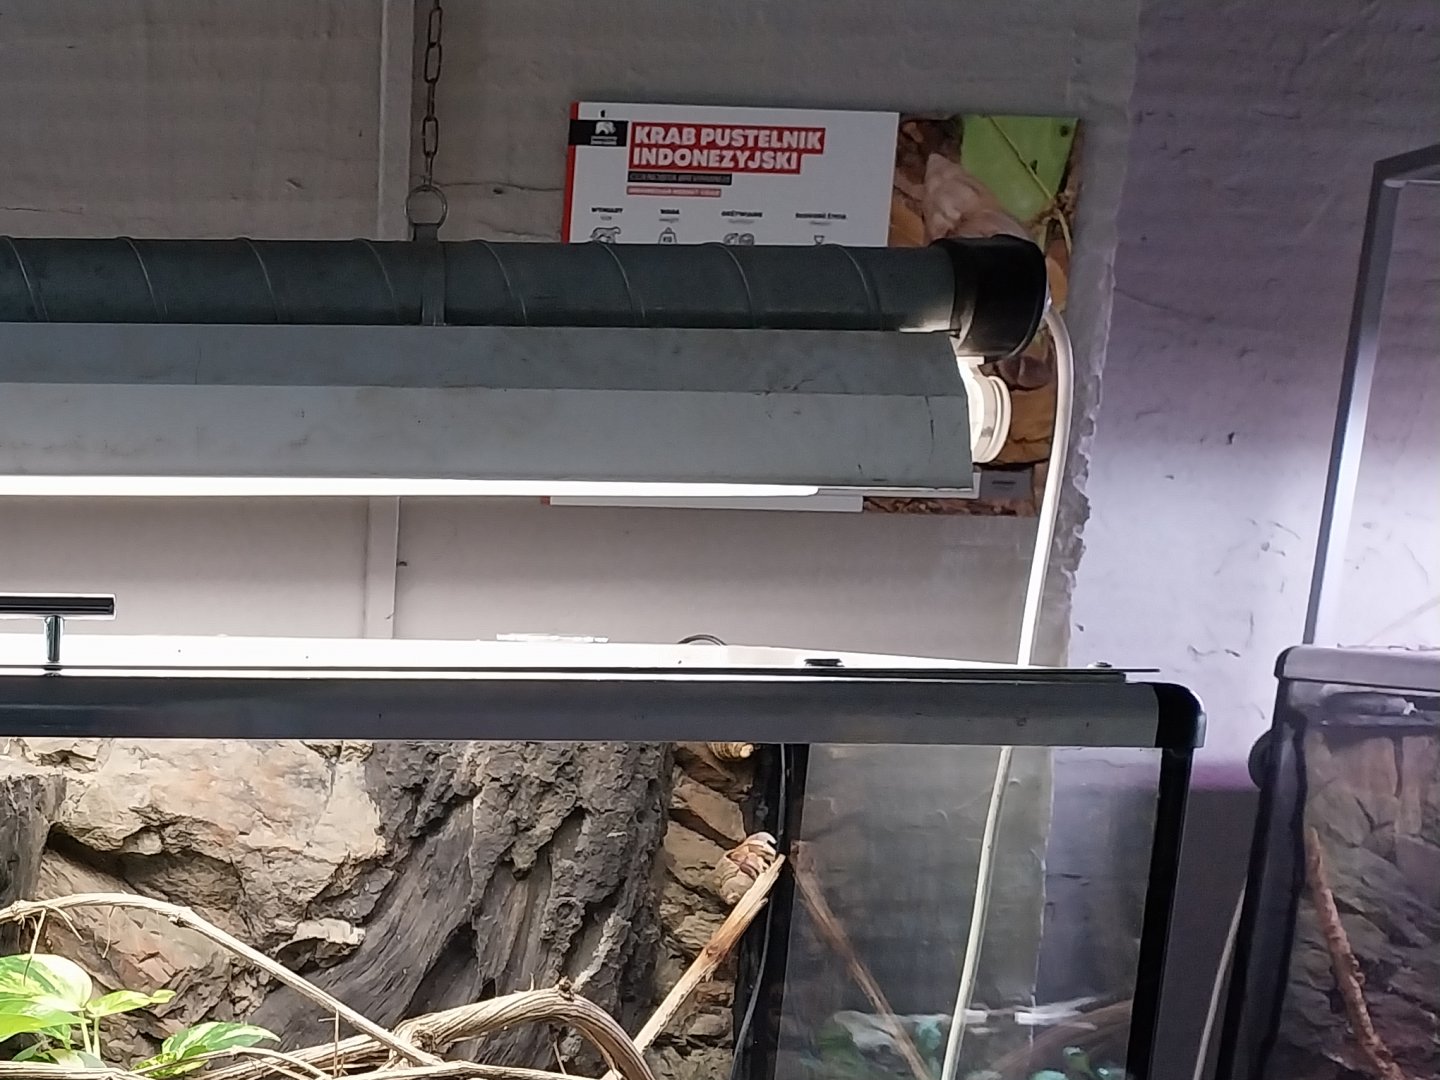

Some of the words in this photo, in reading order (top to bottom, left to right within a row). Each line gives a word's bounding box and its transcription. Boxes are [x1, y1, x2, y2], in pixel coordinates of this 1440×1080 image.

[635, 126, 696, 146] KRAB
[700, 128, 822, 149] PUSTELNIK
[633, 147, 798, 170] INDONEZYJSKI
